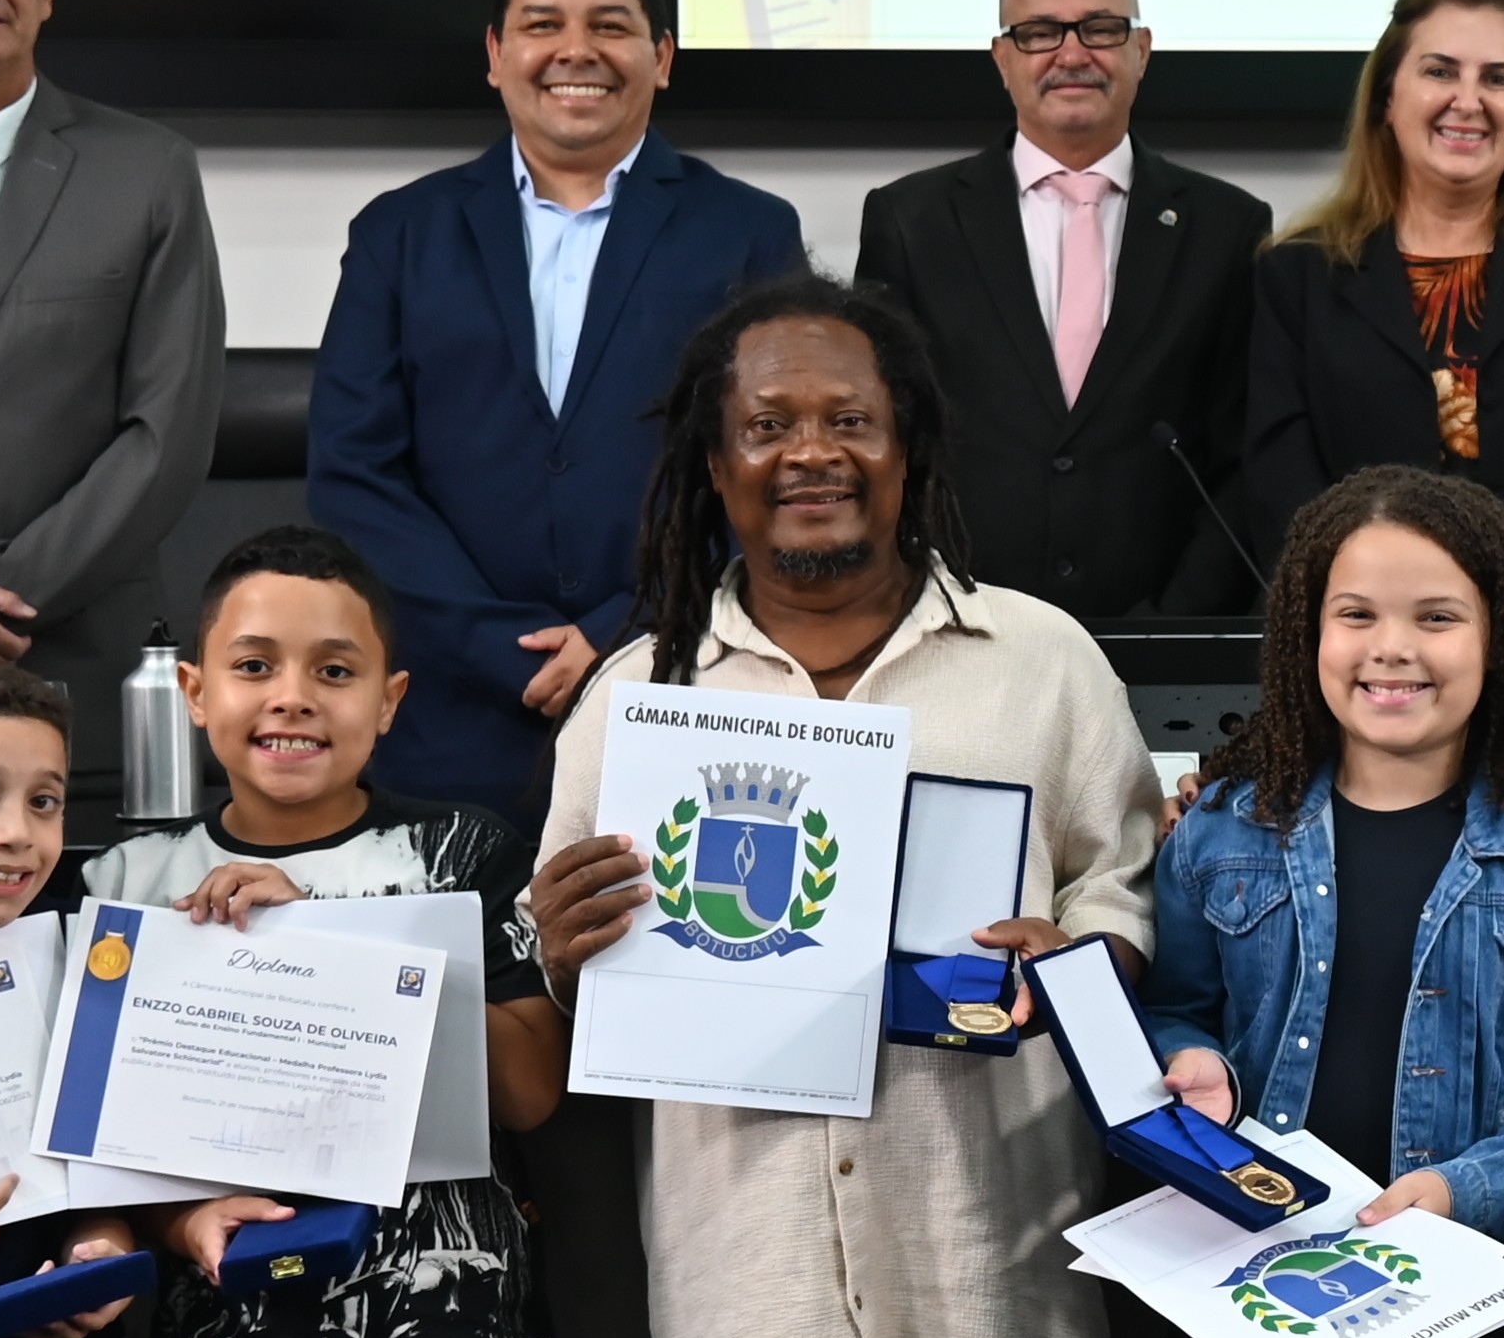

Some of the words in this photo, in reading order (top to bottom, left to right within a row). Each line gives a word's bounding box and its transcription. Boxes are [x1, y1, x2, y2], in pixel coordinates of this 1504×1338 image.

[625, 701, 690, 729] CÂMARA
[695, 712, 783, 739] MUNICIPAL
[787, 723, 808, 741] DE
[812, 726, 895, 750] BOTUCATU
[684, 922, 788, 959] BOTUCATU
[227, 947, 317, 980] Diploma
[132, 997, 182, 1014] ENZZO
[185, 1005, 249, 1024] GABRIEL
[251, 1015, 303, 1032] SOUZA
[306, 1023, 326, 1036] DE
[329, 1027, 398, 1047] OLIVEIRA
[212, 1024, 240, 1033] Ensino
[241, 1028, 296, 1042] Fundamental
[306, 1038, 346, 1050] Municipal
[175, 1042, 216, 1055] Destaque
[218, 1048, 270, 1062] Educacional
[317, 1063, 362, 1076] Professora
[1243, 1240, 1330, 1279] BOTUCATU
